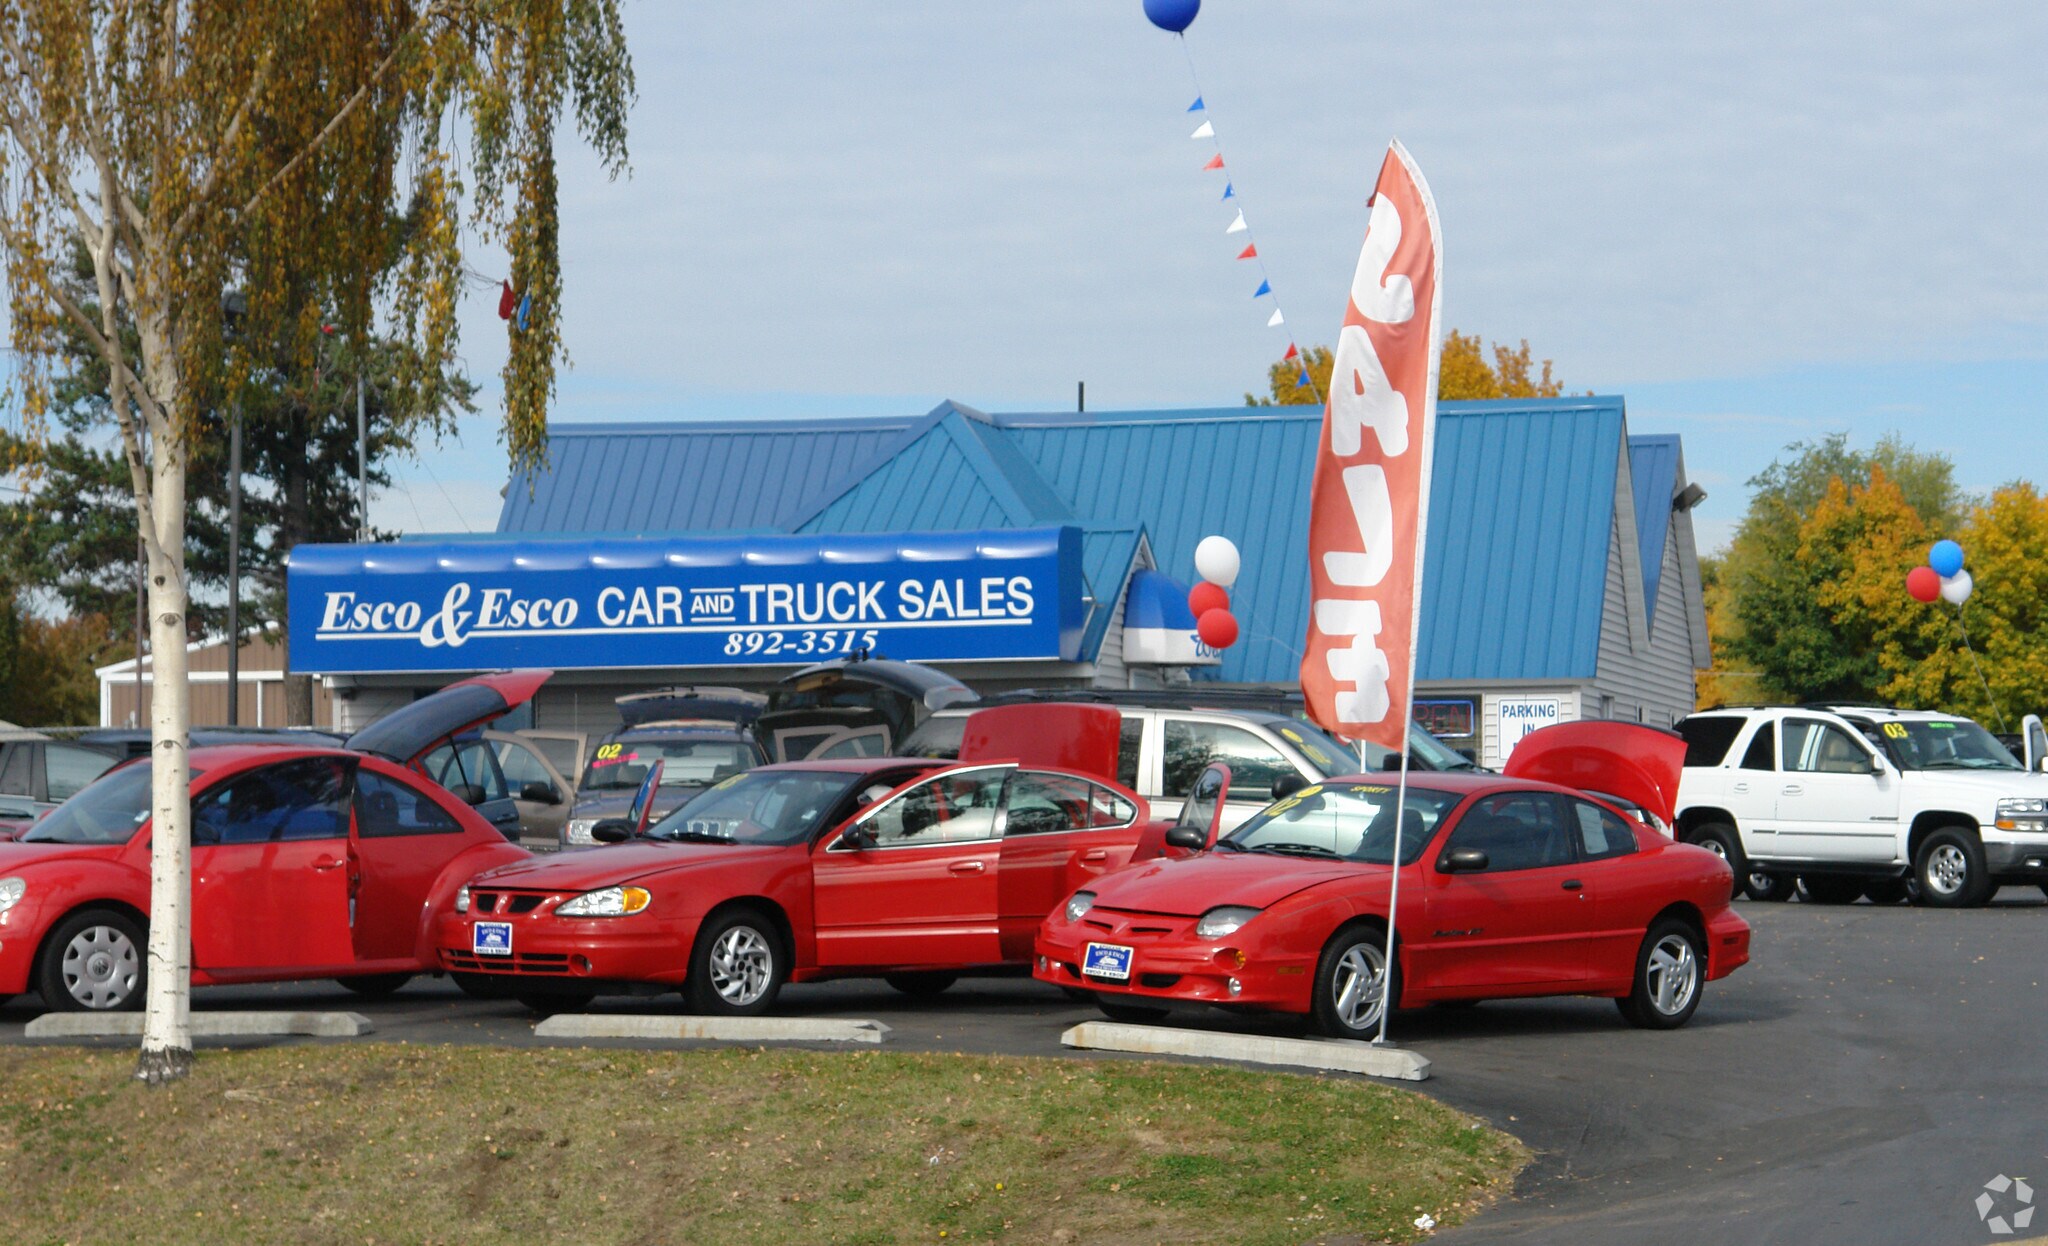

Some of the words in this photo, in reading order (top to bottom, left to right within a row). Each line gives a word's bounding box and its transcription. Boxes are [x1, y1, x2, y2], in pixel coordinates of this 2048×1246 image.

[316, 591, 421, 631] Esco
[419, 582, 473, 648] &
[473, 588, 579, 628] Esco
[597, 585, 684, 626] CAR
[690, 594, 735, 614] AND
[740, 581, 887, 623] TRUCK
[898, 576, 1034, 619] SALES
[724, 630, 879, 656] 892-3515
[1412, 704, 1471, 734] PEN
[1502, 704, 1556, 718] PARKING
[1883, 722, 1908, 739] 03
[597, 743, 622, 760] 02
